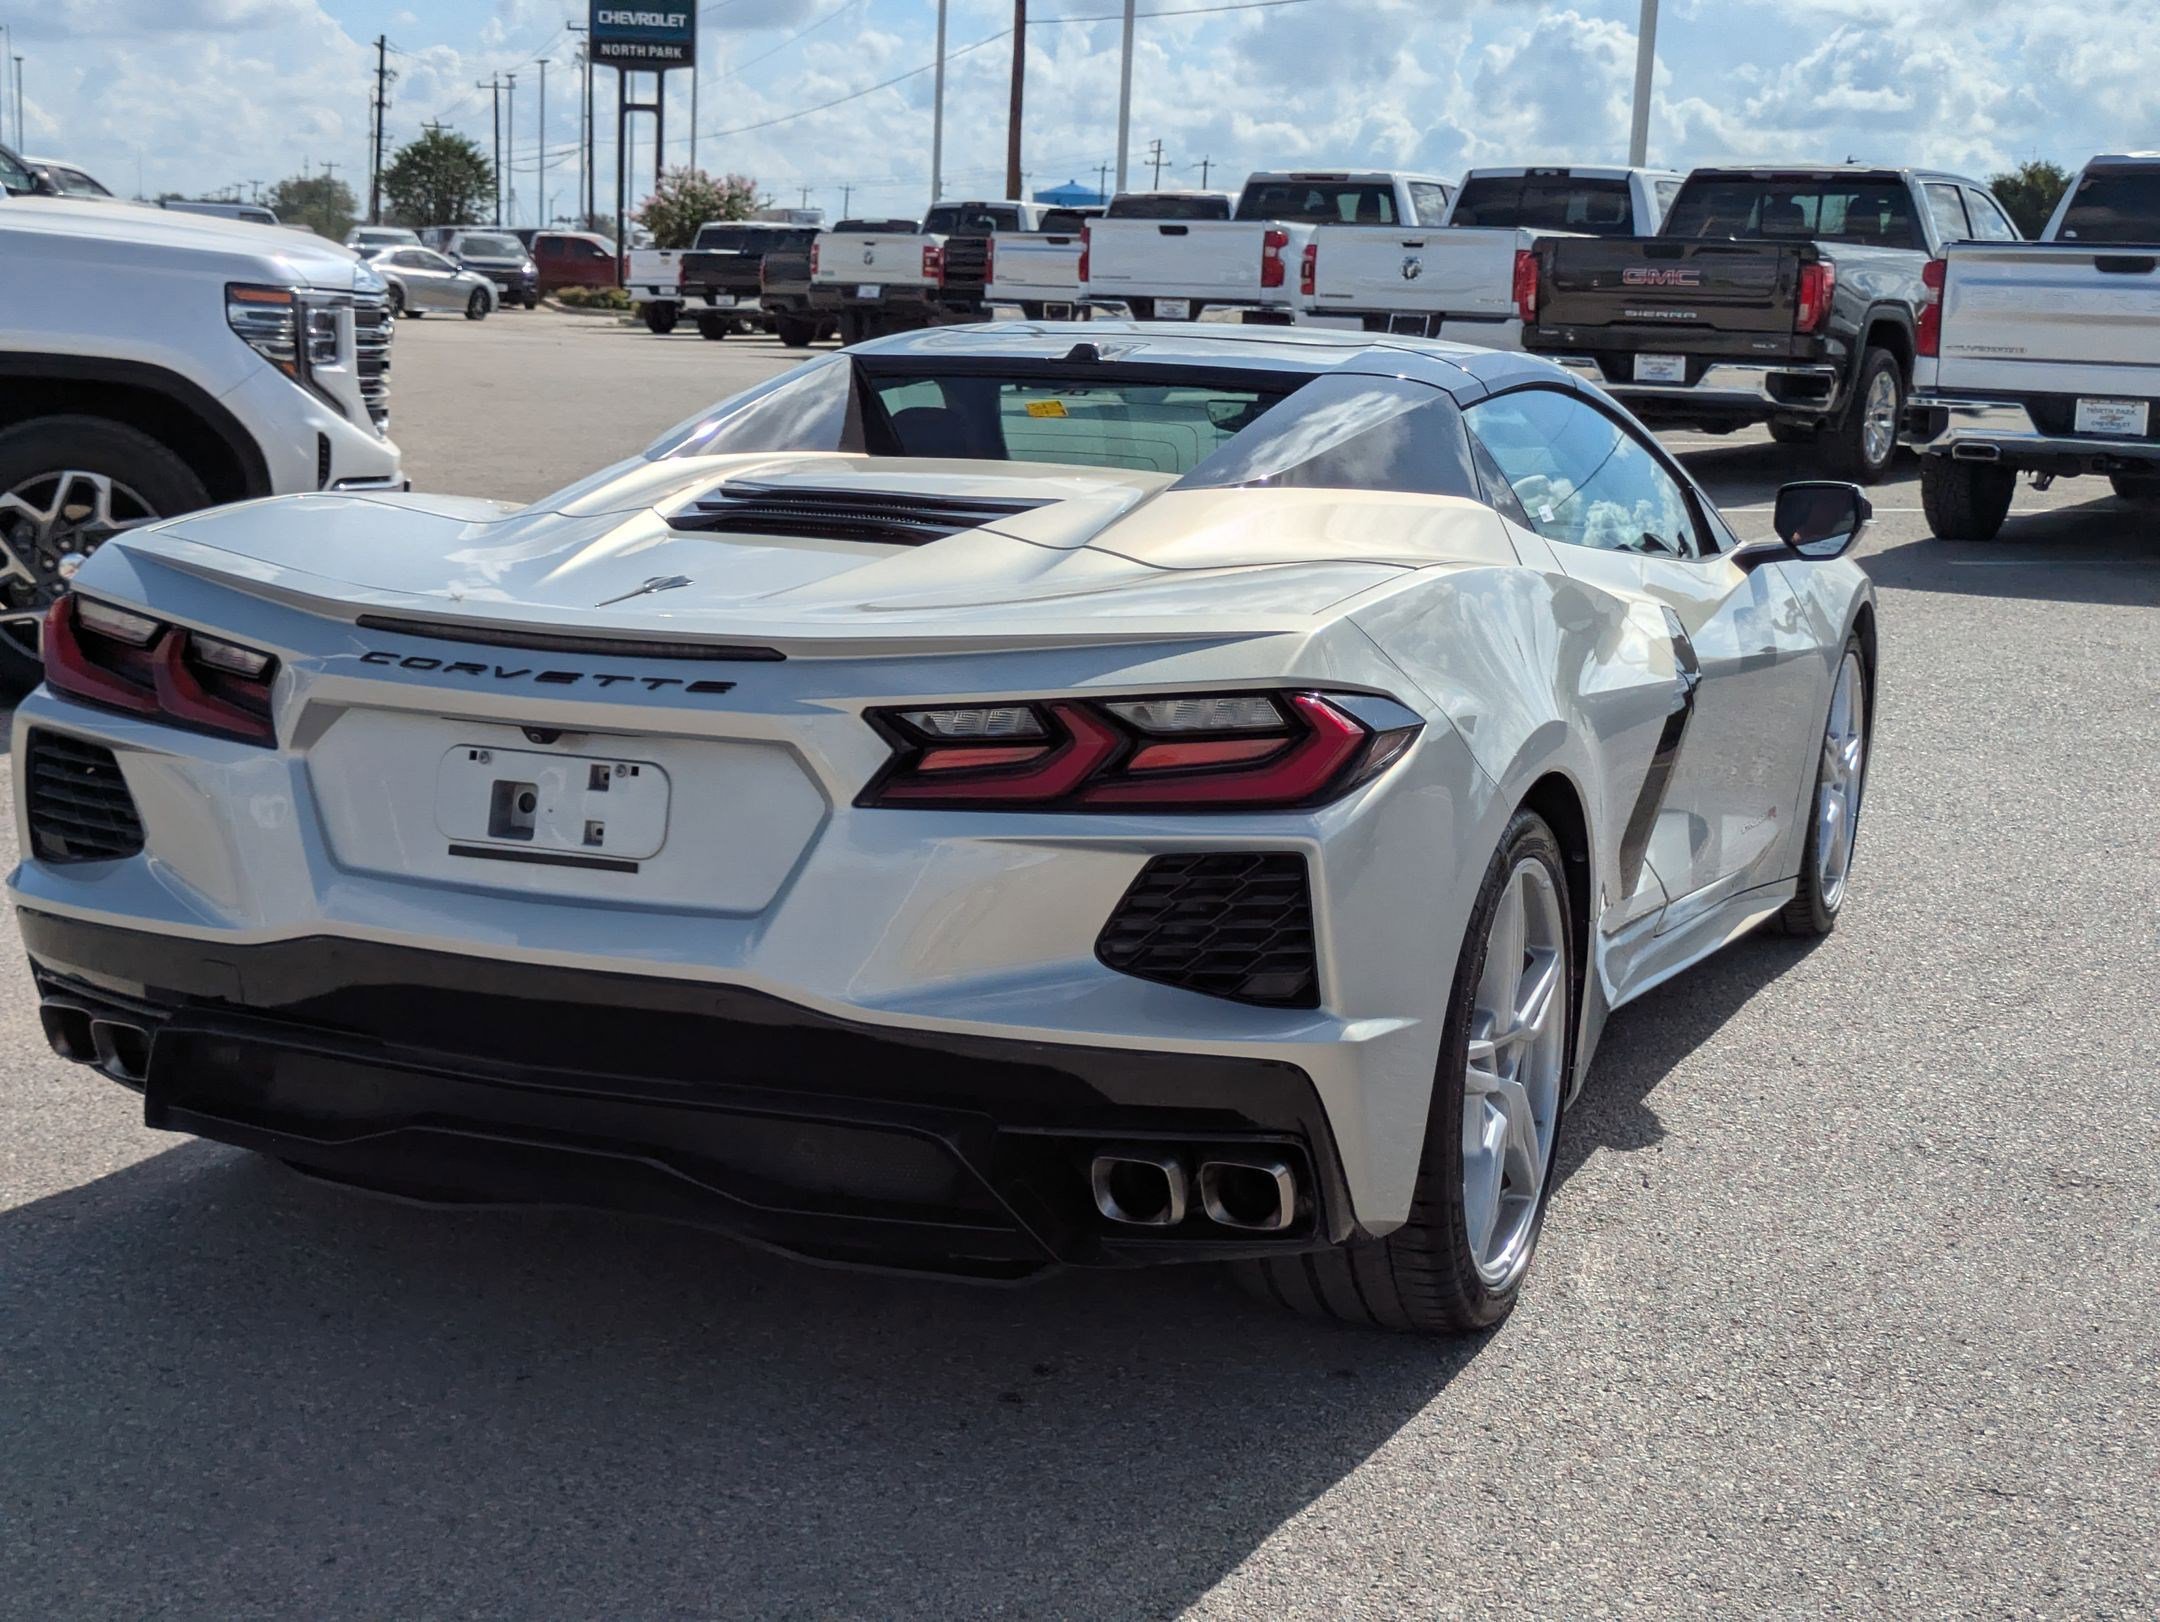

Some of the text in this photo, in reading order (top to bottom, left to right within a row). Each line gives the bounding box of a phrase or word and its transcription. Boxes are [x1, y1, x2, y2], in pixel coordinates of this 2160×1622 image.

[598, 10, 687, 28] CHEVROLET
[600, 44, 682, 59] NORTH PARK
[1622, 267, 1702, 286] GMC
[1624, 309, 1698, 319] SIERRA
[359, 651, 738, 695] CORVETTE
